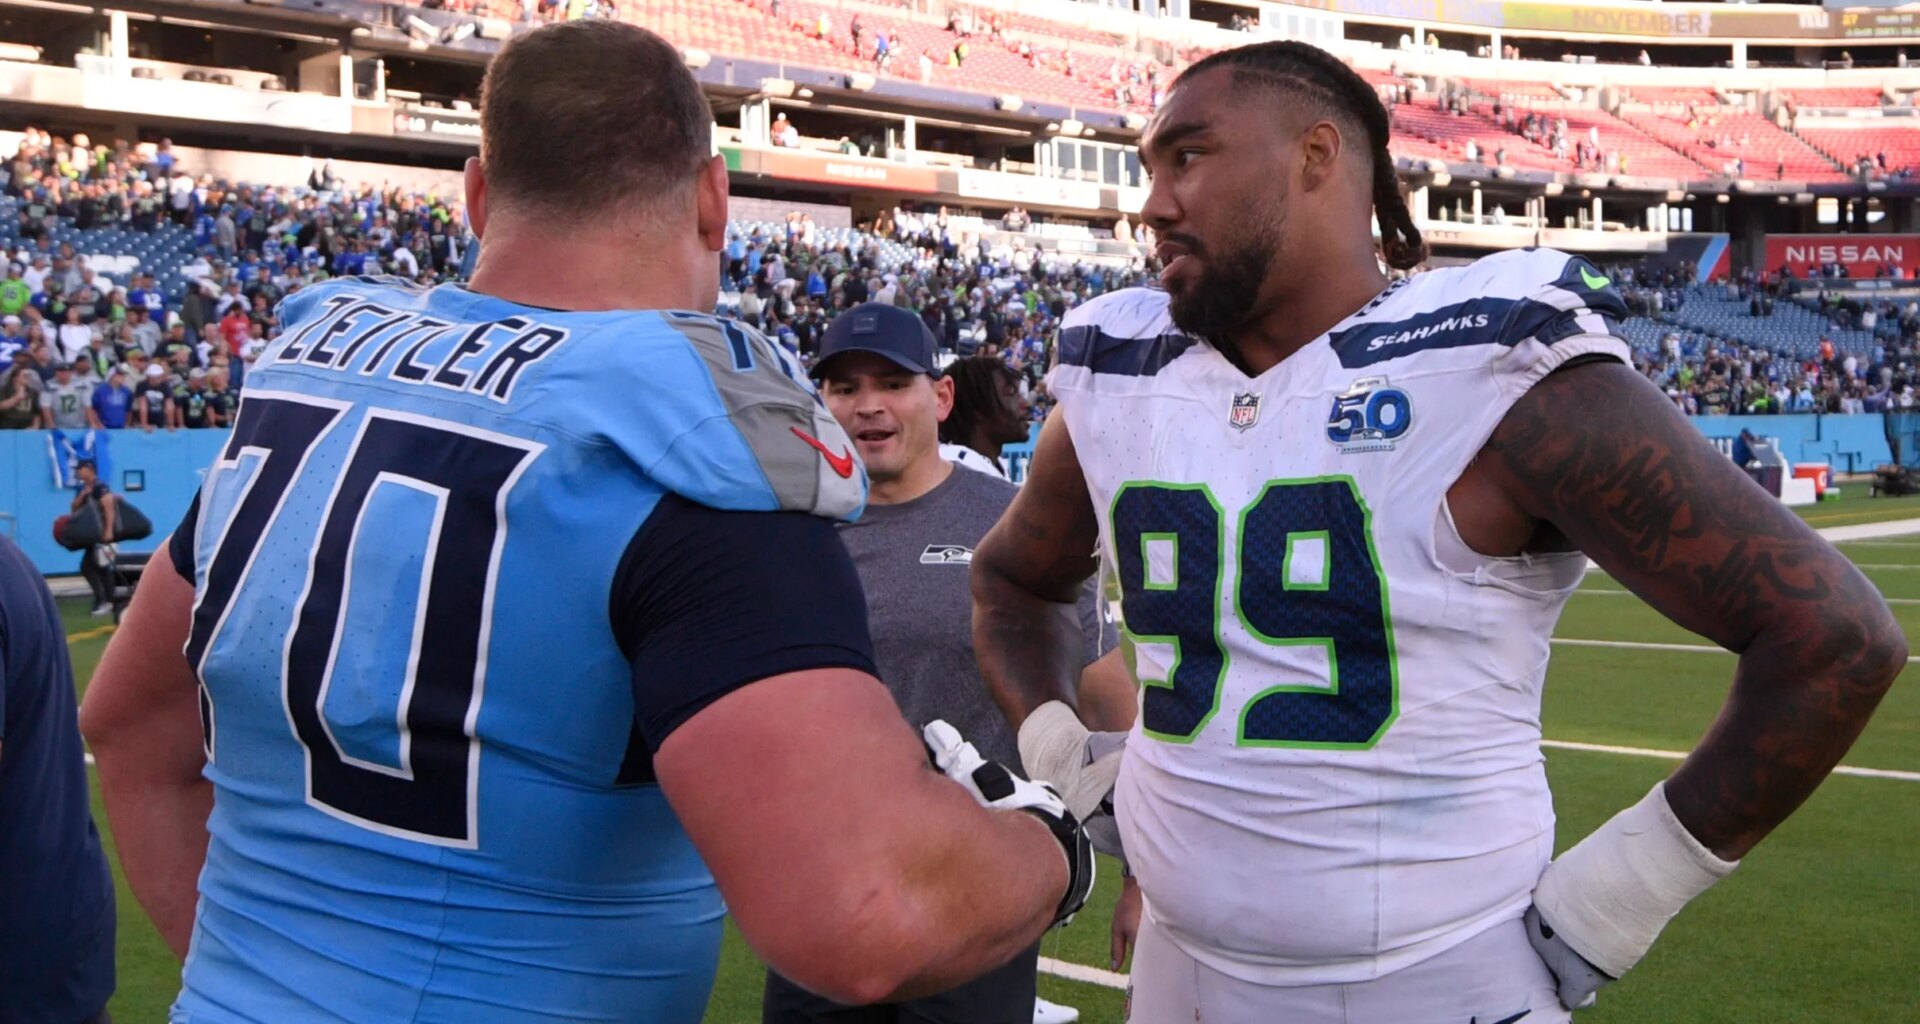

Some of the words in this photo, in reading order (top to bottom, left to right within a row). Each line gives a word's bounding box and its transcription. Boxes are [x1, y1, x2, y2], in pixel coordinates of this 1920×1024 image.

[1572, 9, 1703, 34] NOVEMBER
[1785, 245, 1903, 262] NISSAN
[272, 293, 571, 405] ZEITLER
[1366, 314, 1489, 352] SEAHAWKS
[1232, 406, 1253, 424] NFL
[1327, 389, 1411, 442] 50
[182, 388, 548, 850] 70
[1109, 474, 1399, 751] 99
